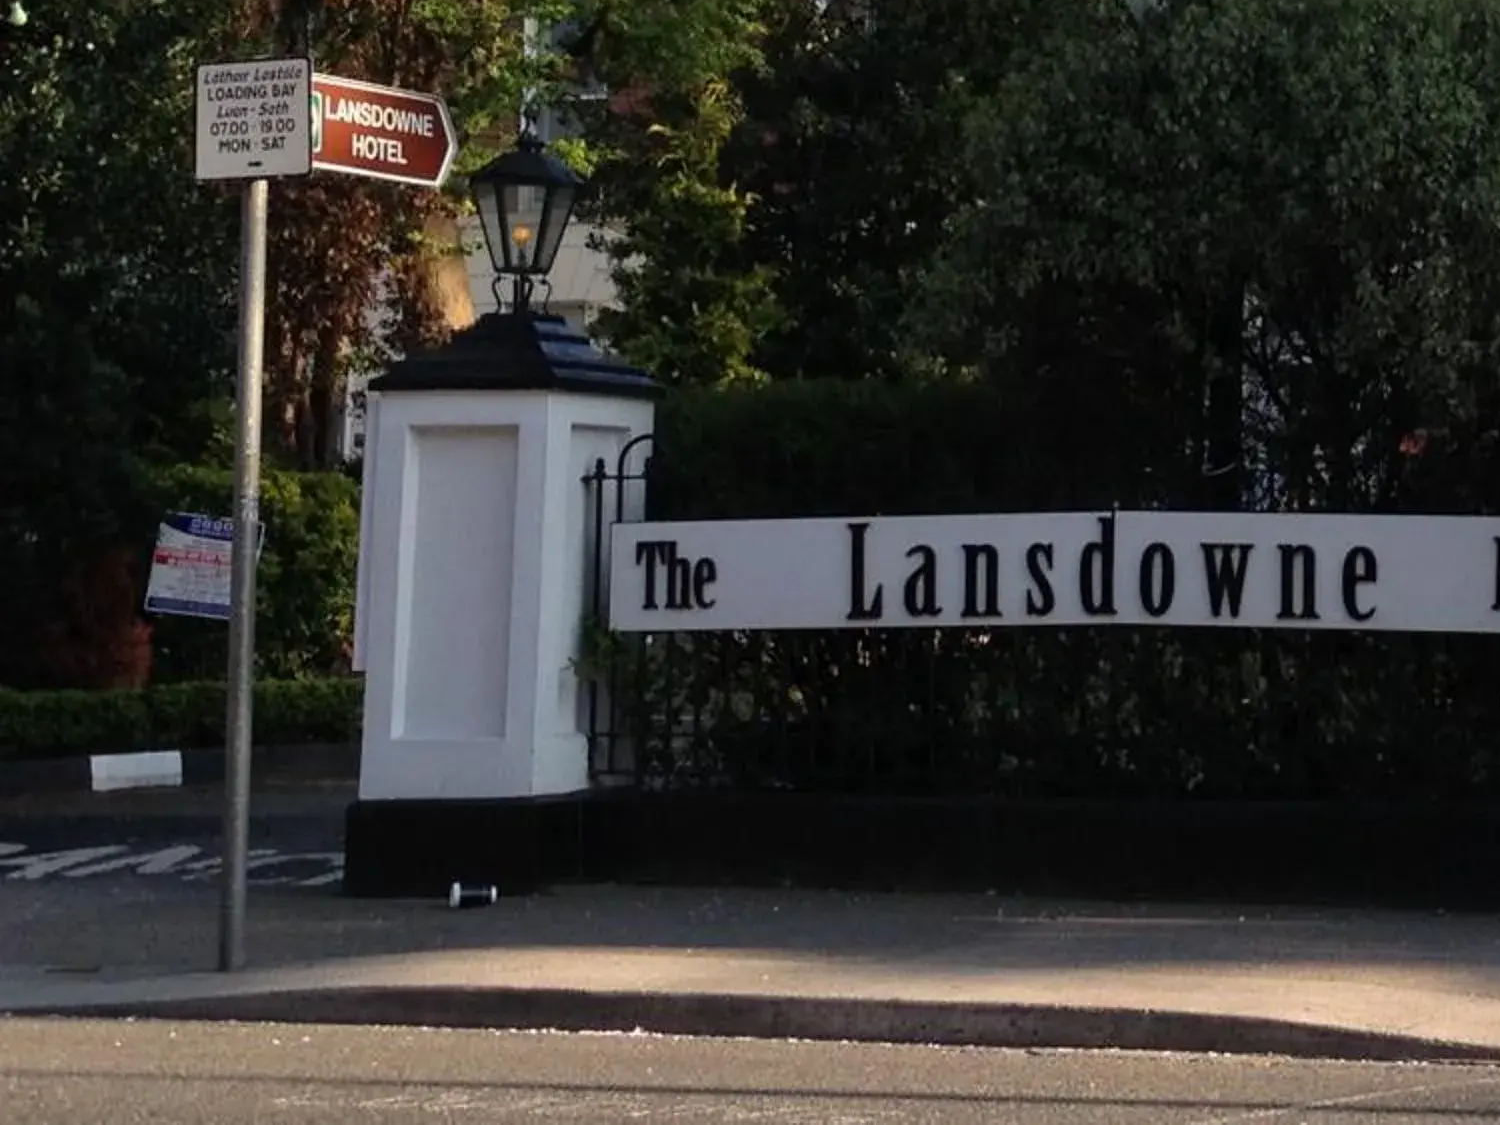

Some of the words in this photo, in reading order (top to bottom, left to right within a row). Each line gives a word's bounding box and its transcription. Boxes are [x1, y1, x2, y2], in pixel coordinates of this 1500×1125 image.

[207, 84, 267, 102] LOADING
[272, 82, 297, 98] BAY
[325, 95, 434, 138] LANSDOWNE
[219, 138, 251, 153] MON
[261, 136, 286, 151] SAT
[352, 133, 408, 165] HOTEL
[636, 540, 717, 610] The
[847, 516, 1377, 623] Lansdowne
